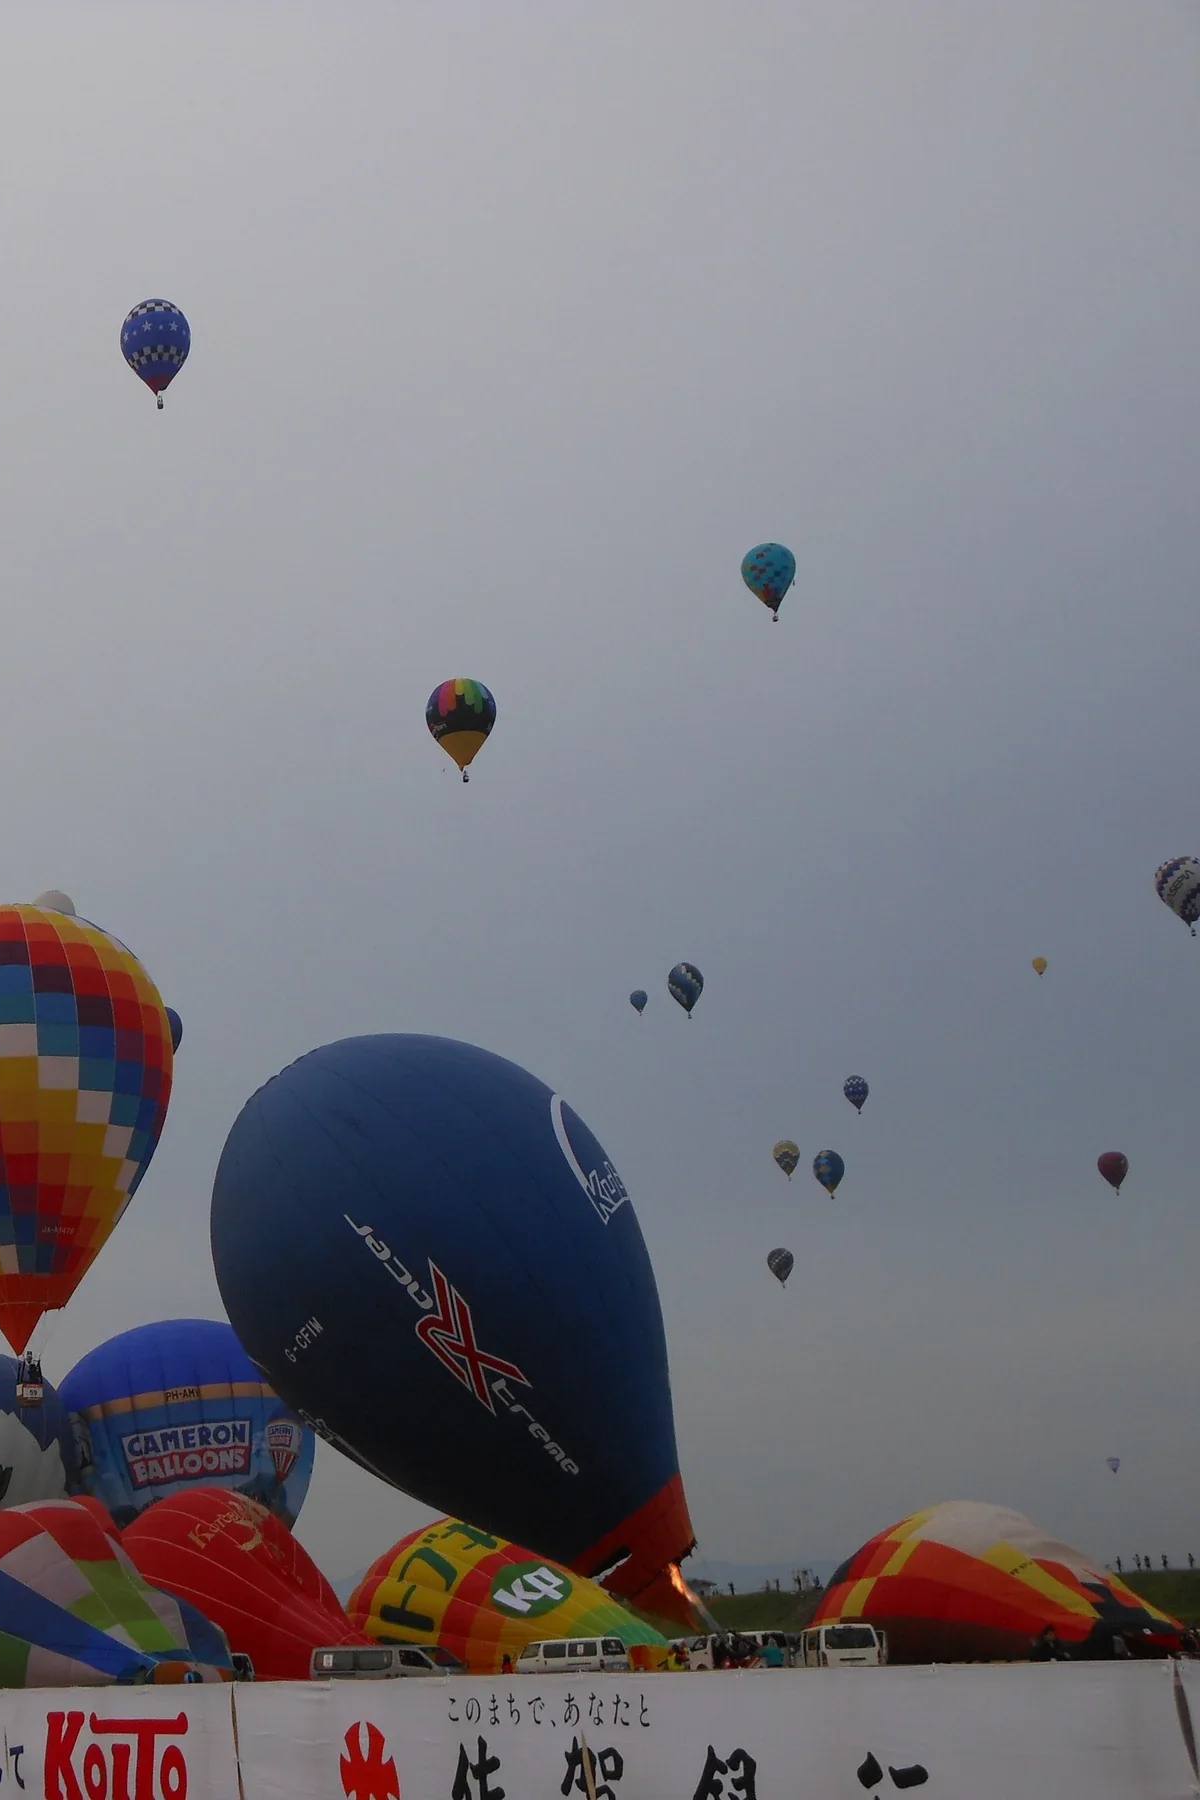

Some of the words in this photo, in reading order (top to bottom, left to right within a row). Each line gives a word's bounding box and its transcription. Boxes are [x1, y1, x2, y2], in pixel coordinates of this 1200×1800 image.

[127, 1423, 246, 1457] CAMERON
[133, 1449, 246, 1482] BALLOONS
[447, 1693, 652, 1729] このまちで、あなたと
